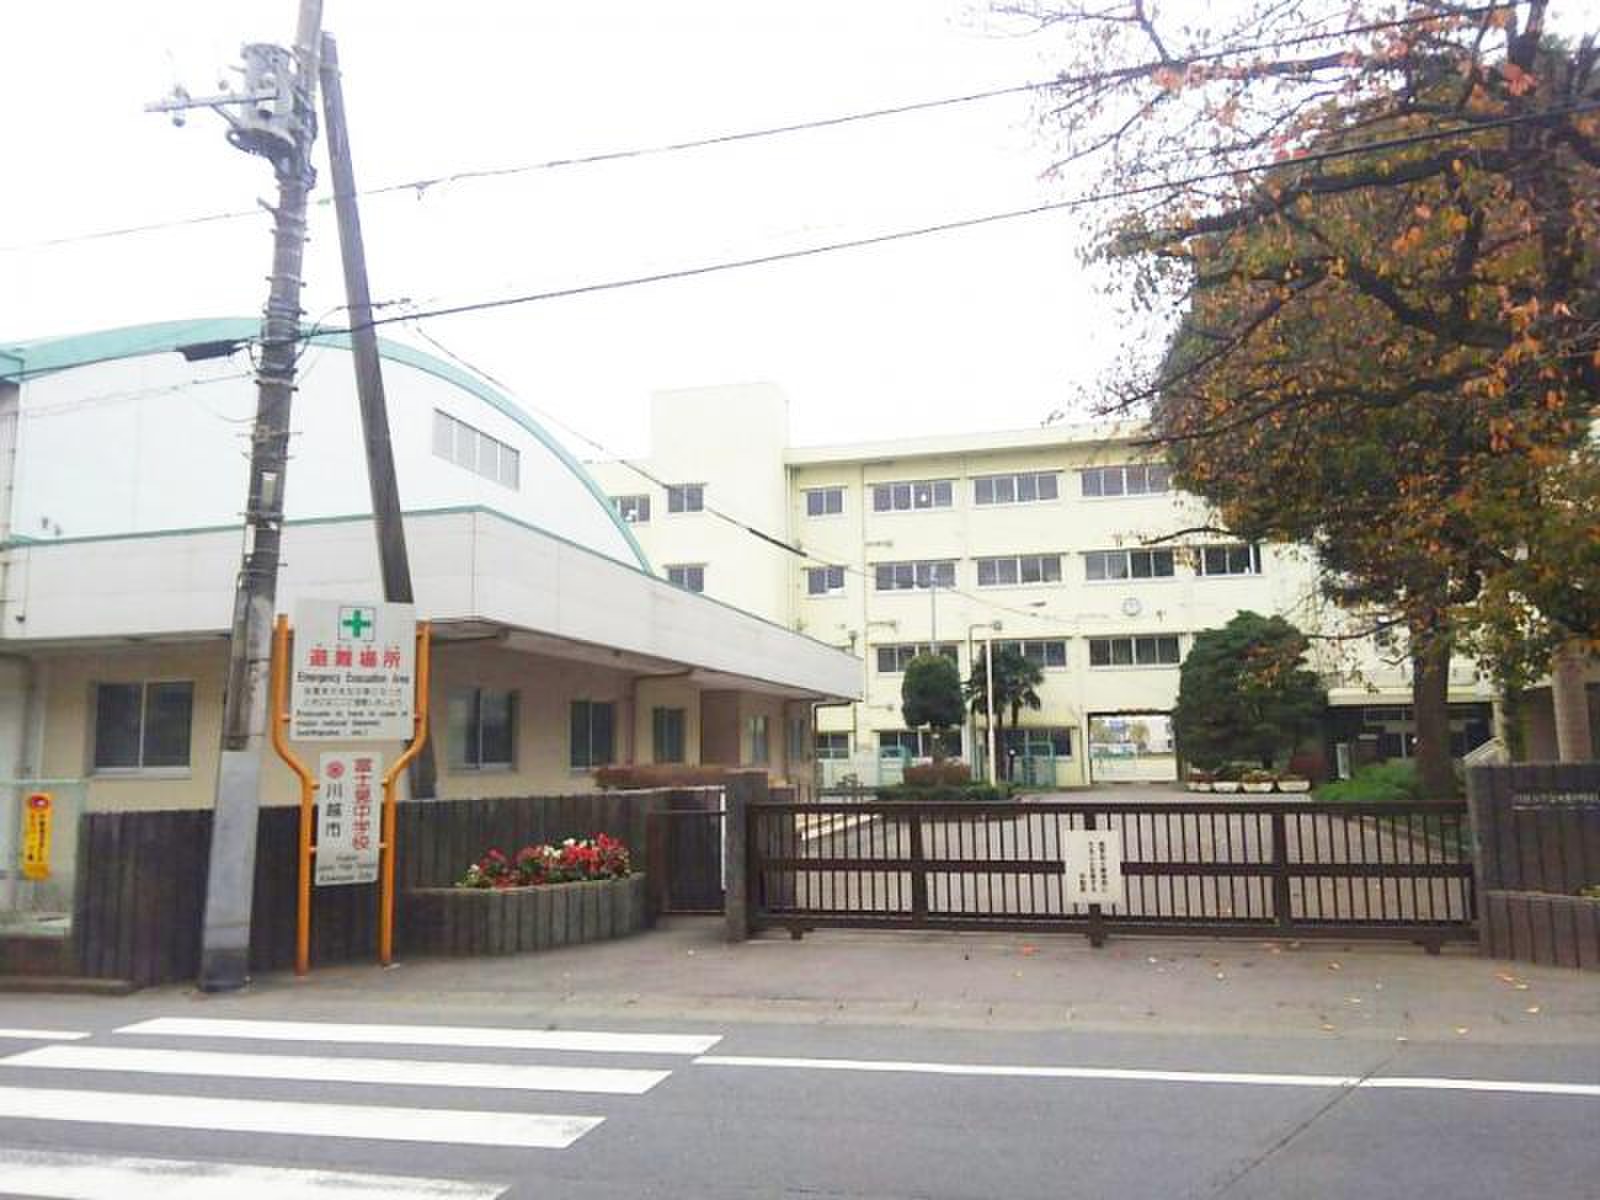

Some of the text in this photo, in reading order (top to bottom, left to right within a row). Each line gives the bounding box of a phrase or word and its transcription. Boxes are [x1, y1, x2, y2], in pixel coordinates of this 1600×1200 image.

[309, 648, 401, 668] 避難場所
[297, 671, 341, 684] Emergency
[346, 671, 387, 684] Evacuation
[326, 783, 343, 838] 川越市
